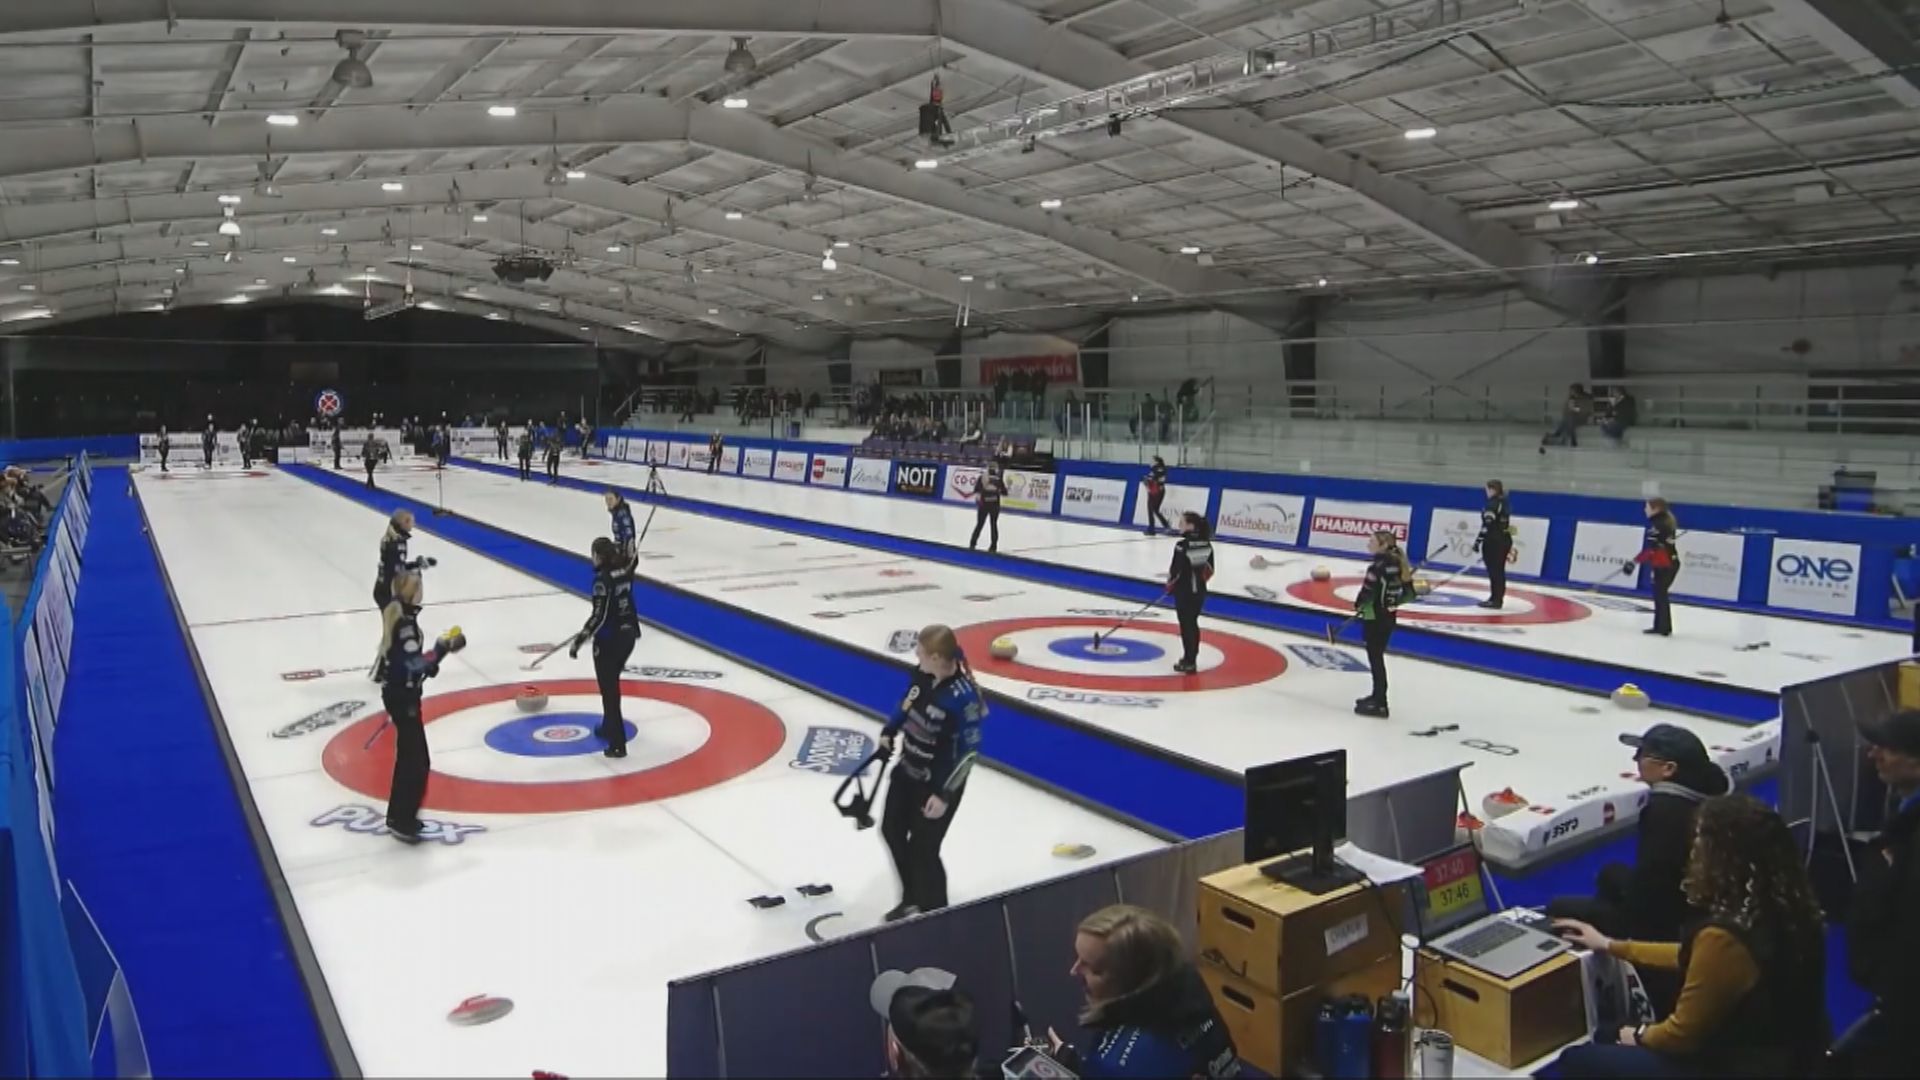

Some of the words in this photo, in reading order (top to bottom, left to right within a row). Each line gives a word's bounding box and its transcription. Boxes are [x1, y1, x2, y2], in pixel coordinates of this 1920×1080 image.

[897, 466, 936, 488] NOTT
[954, 475, 978, 485] CO-O
[1220, 514, 1270, 532] Manitoba
[1315, 517, 1405, 538] PHARMASAVE
